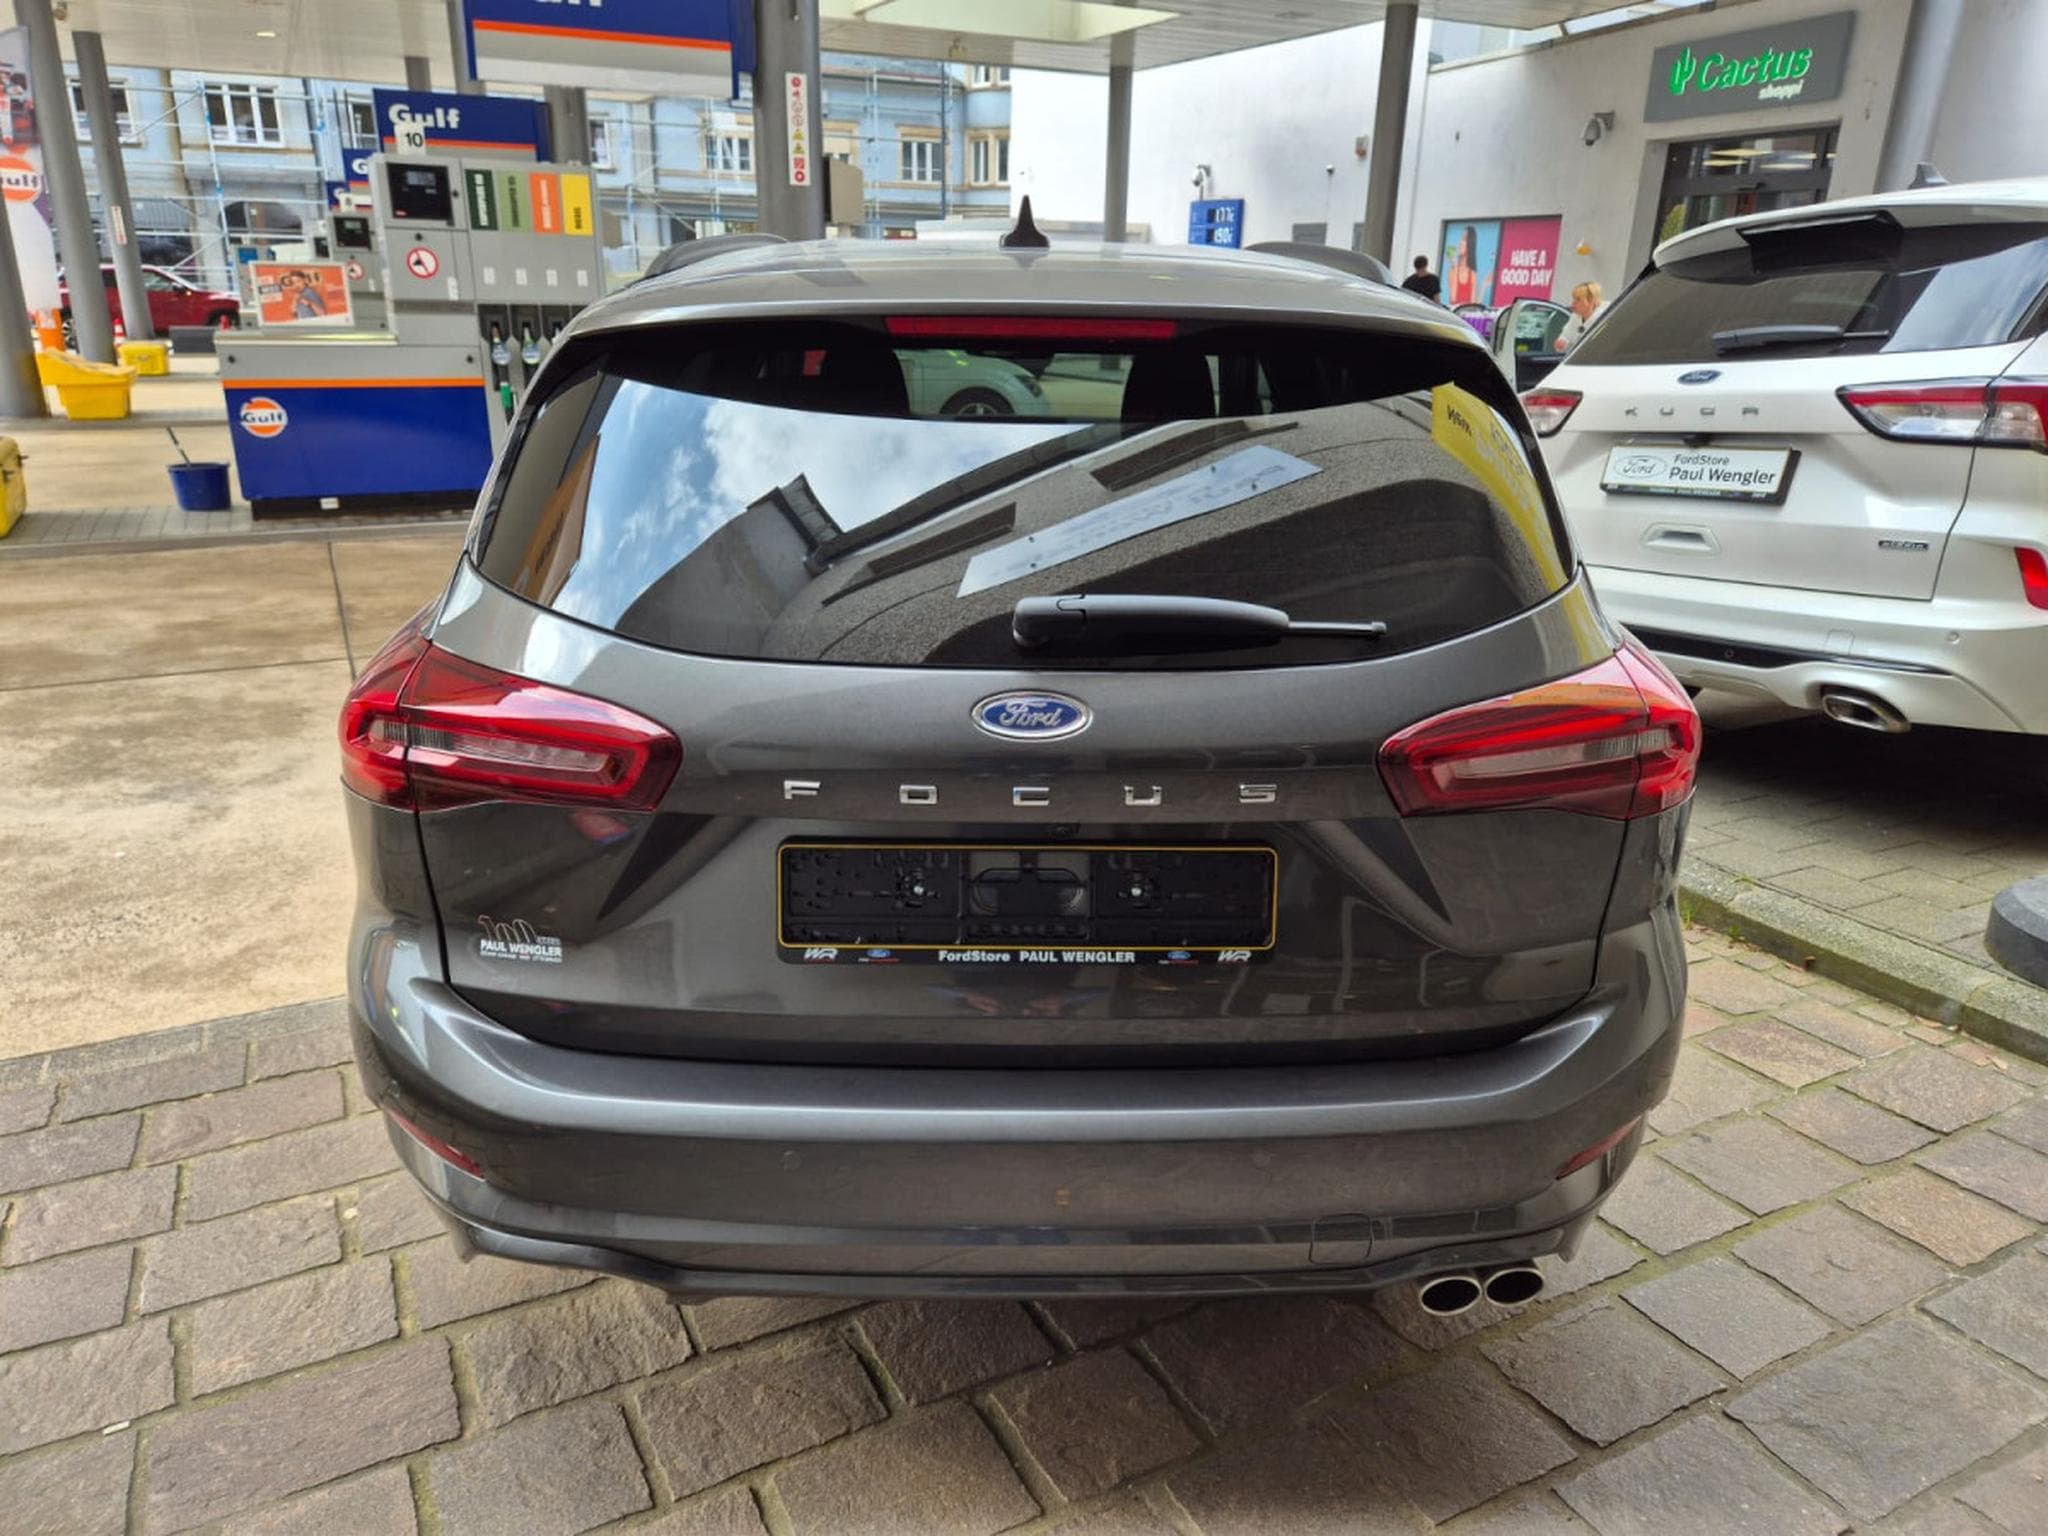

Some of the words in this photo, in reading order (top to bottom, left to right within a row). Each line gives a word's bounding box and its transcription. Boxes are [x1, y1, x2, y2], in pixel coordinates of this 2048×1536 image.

[1697, 48, 1813, 91] Cactus
[388, 103, 460, 129] Gulf
[405, 132, 423, 147] 10
[0, 174, 38, 188] ulf
[1510, 250, 1538, 266] HAVE
[1538, 250, 1547, 266] A
[1501, 269, 1529, 286] GOOD
[1530, 269, 1552, 286] DAY
[243, 411, 283, 423] Gulf
[1623, 456, 1657, 475] Ford
[1674, 454, 1730, 467] FordStore
[1668, 466, 1703, 481] Paul
[1708, 468, 1776, 485] Wengler
[999, 697, 1063, 726] Ford
[785, 780, 1277, 806] FOCUS
[480, 938, 508, 951] PAUL
[938, 950, 1011, 962] FordStore
[1019, 950, 1058, 962] PAUL
[1062, 951, 1136, 963] WENGLER
